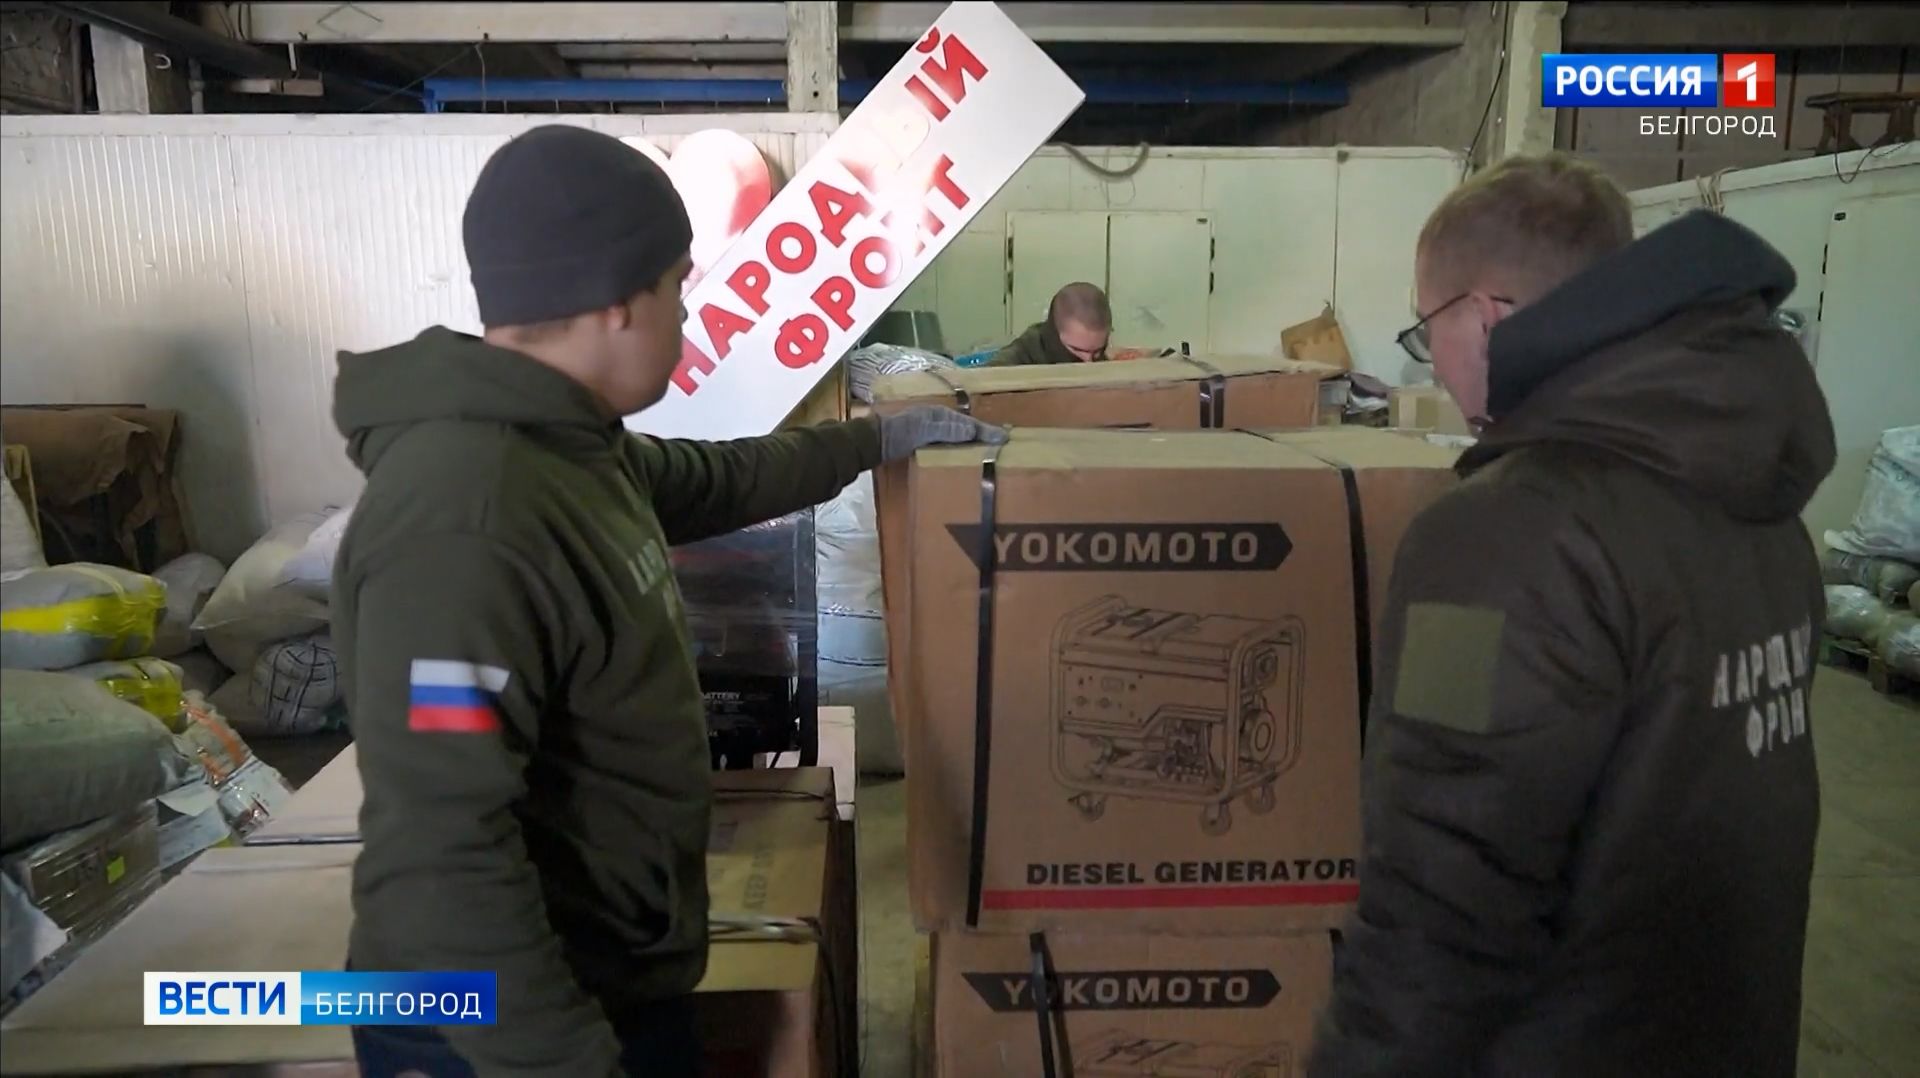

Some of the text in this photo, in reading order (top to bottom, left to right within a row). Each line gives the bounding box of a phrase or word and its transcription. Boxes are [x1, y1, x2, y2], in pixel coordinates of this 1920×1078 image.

[993, 531, 1259, 563] YOKOMOTO
[702, 691, 741, 700] ATTERY
[1027, 858, 1357, 885] DIESEL GENERATOR
[1003, 975, 1250, 1006] YKOMOTO
